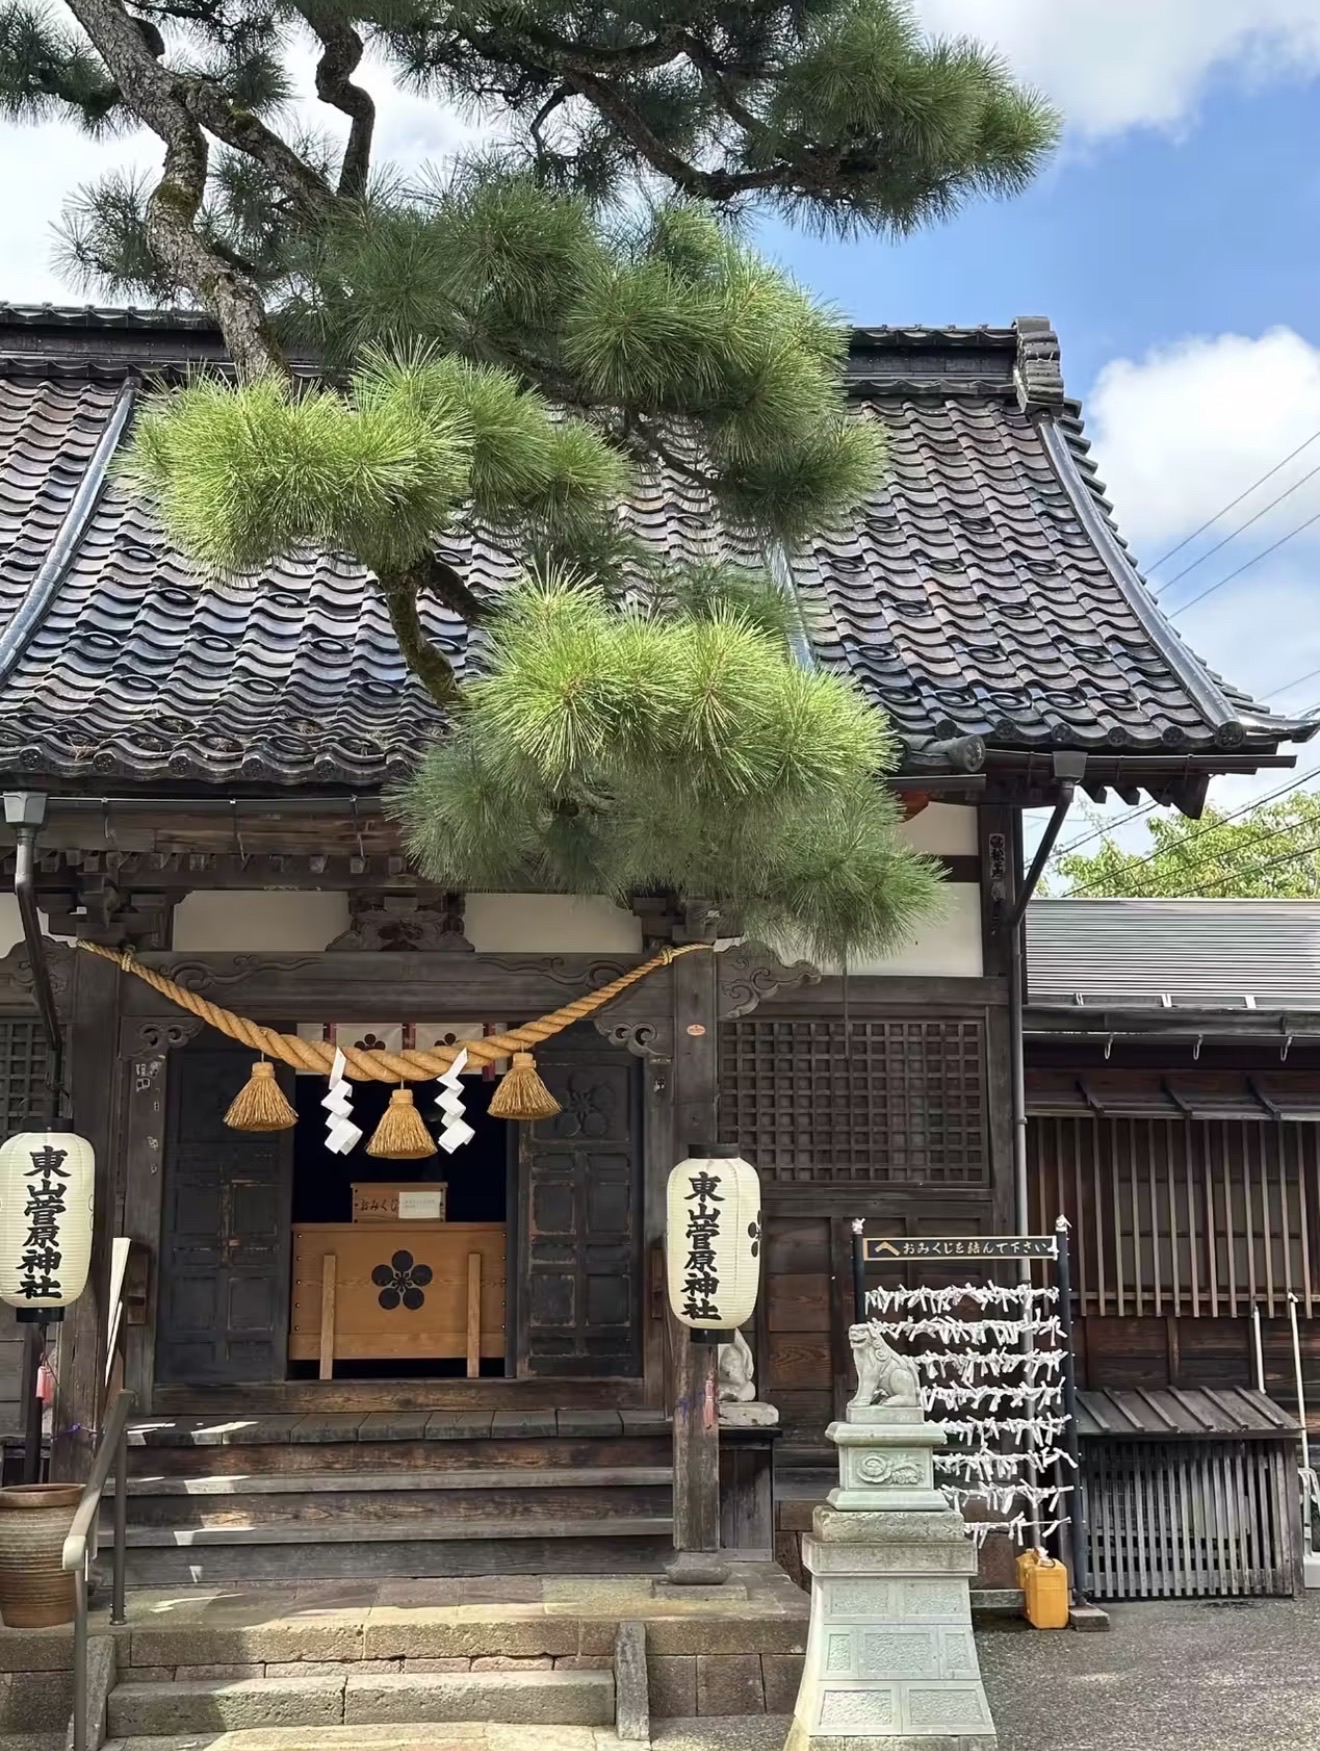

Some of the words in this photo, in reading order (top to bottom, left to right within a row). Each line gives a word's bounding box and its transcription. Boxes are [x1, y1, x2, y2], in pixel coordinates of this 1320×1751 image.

[14, 1145, 72, 1299] 東山菅原神社
[360, 1197, 399, 1212] おみくじ
[680, 1171, 726, 1320] 東山菅原神社
